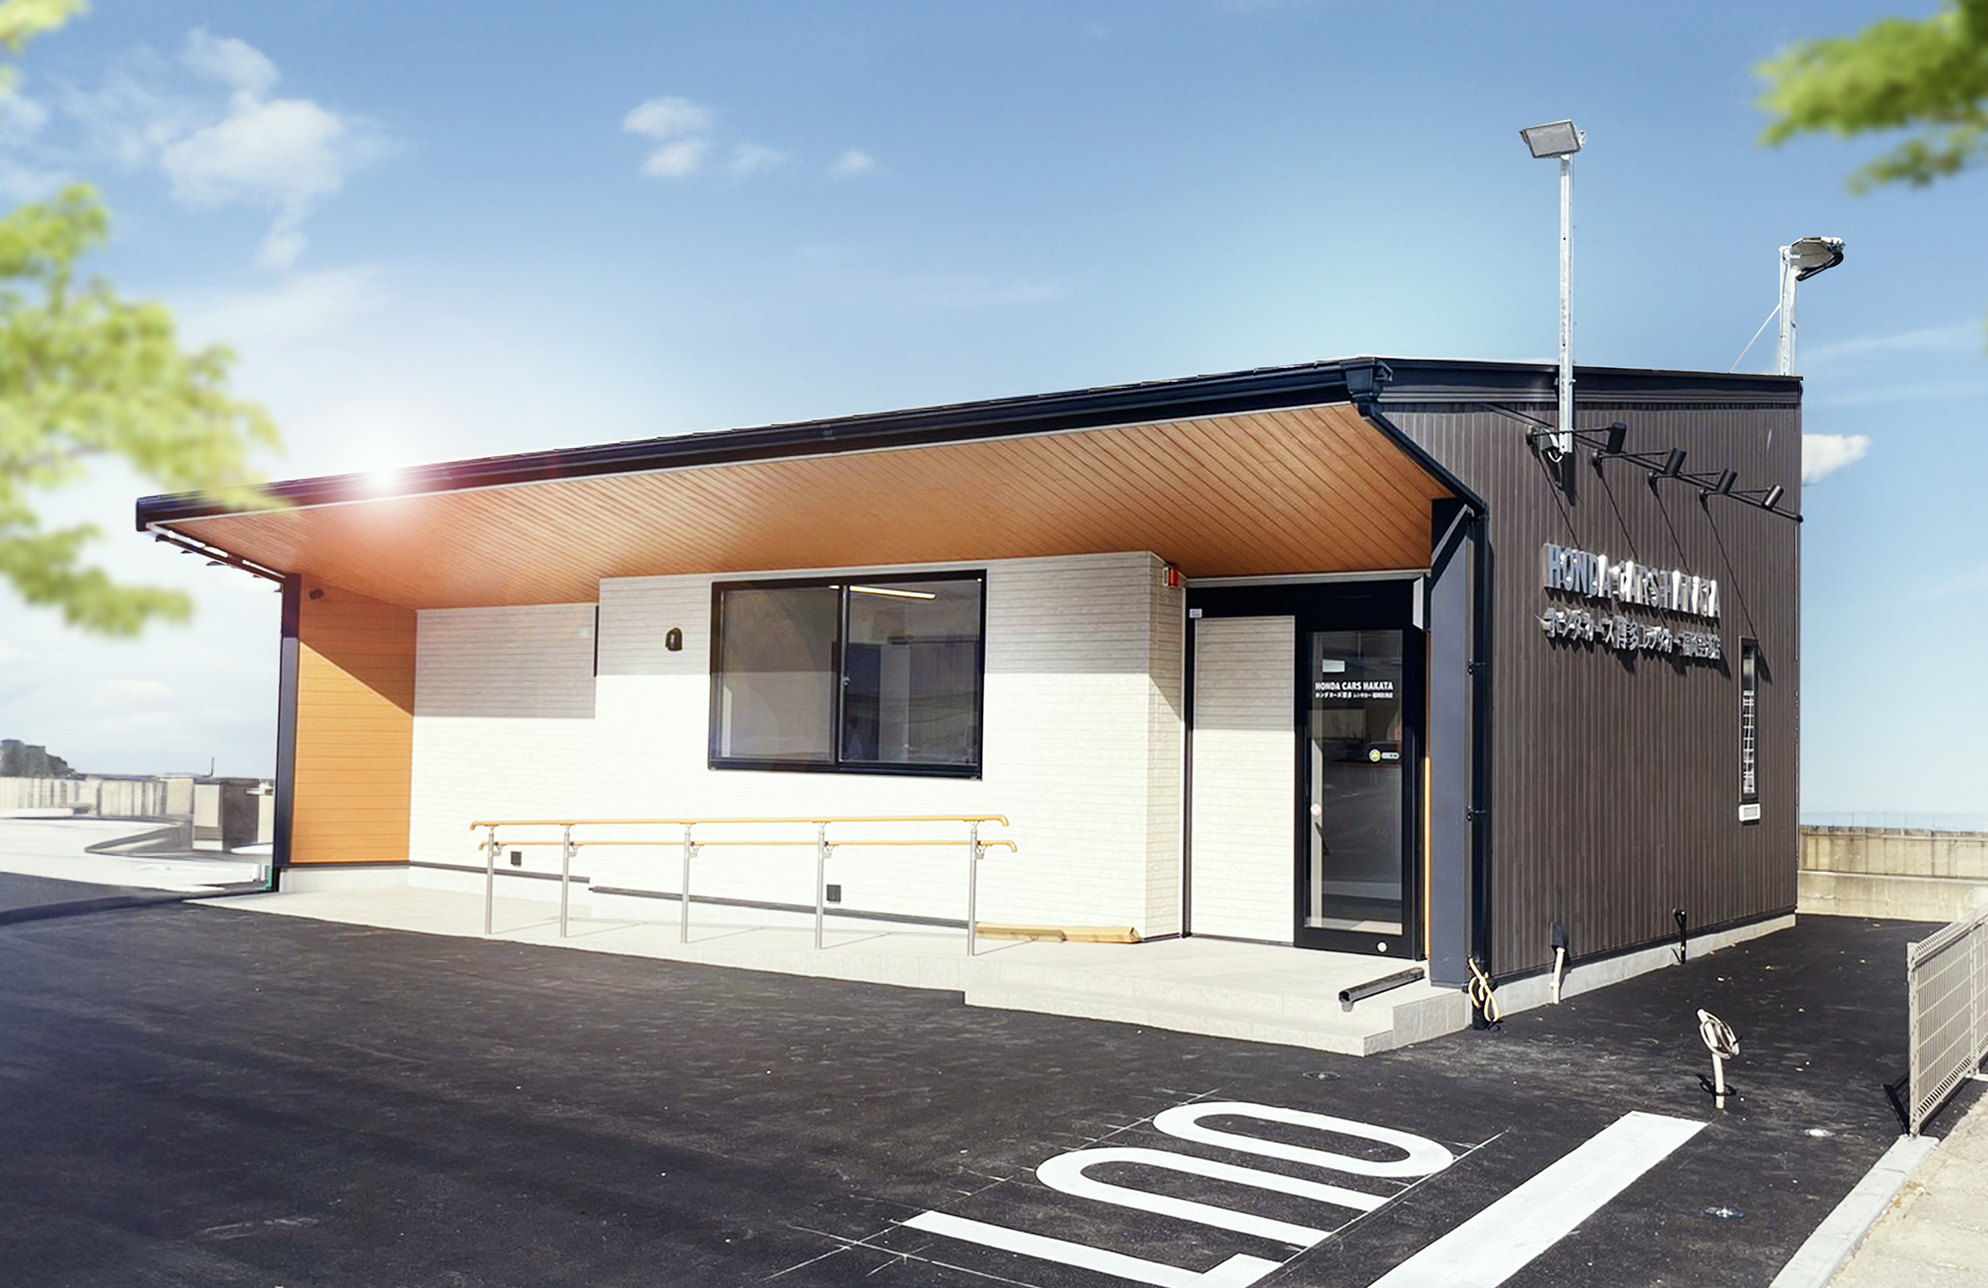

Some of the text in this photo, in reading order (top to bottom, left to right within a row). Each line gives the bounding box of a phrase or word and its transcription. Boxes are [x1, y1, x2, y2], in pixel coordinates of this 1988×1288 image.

[1542, 543, 1612, 599] HONDA
[1314, 682, 1394, 691] HONDA CARS HAKATA
